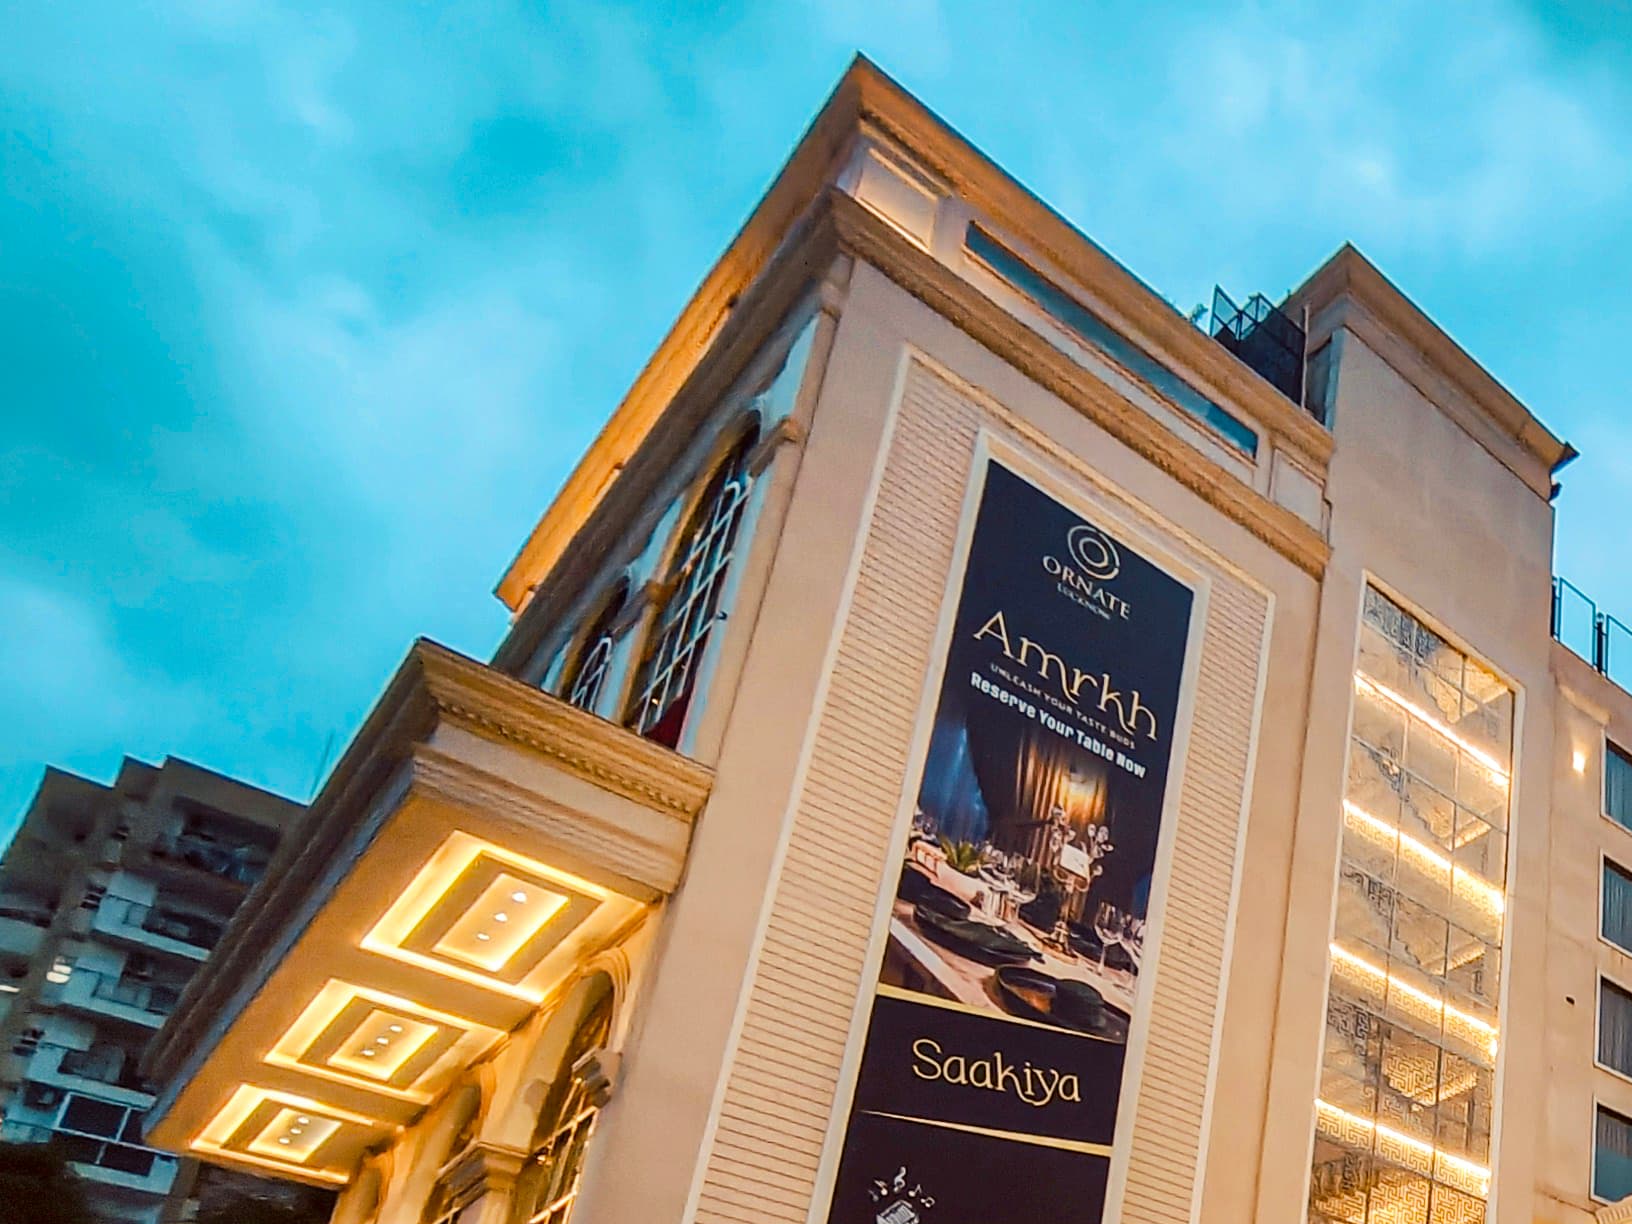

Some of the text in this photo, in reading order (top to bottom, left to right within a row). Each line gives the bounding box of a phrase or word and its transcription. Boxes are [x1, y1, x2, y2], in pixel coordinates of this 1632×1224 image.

[1042, 555, 1131, 620] ORNATE
[973, 610, 1157, 741] Amrkh
[990, 662, 1136, 750] UNLEASH YOUR TASTE BUDS
[970, 671, 1146, 779] Reserve Your Table Now
[912, 1038, 1082, 1106] Saakiya
